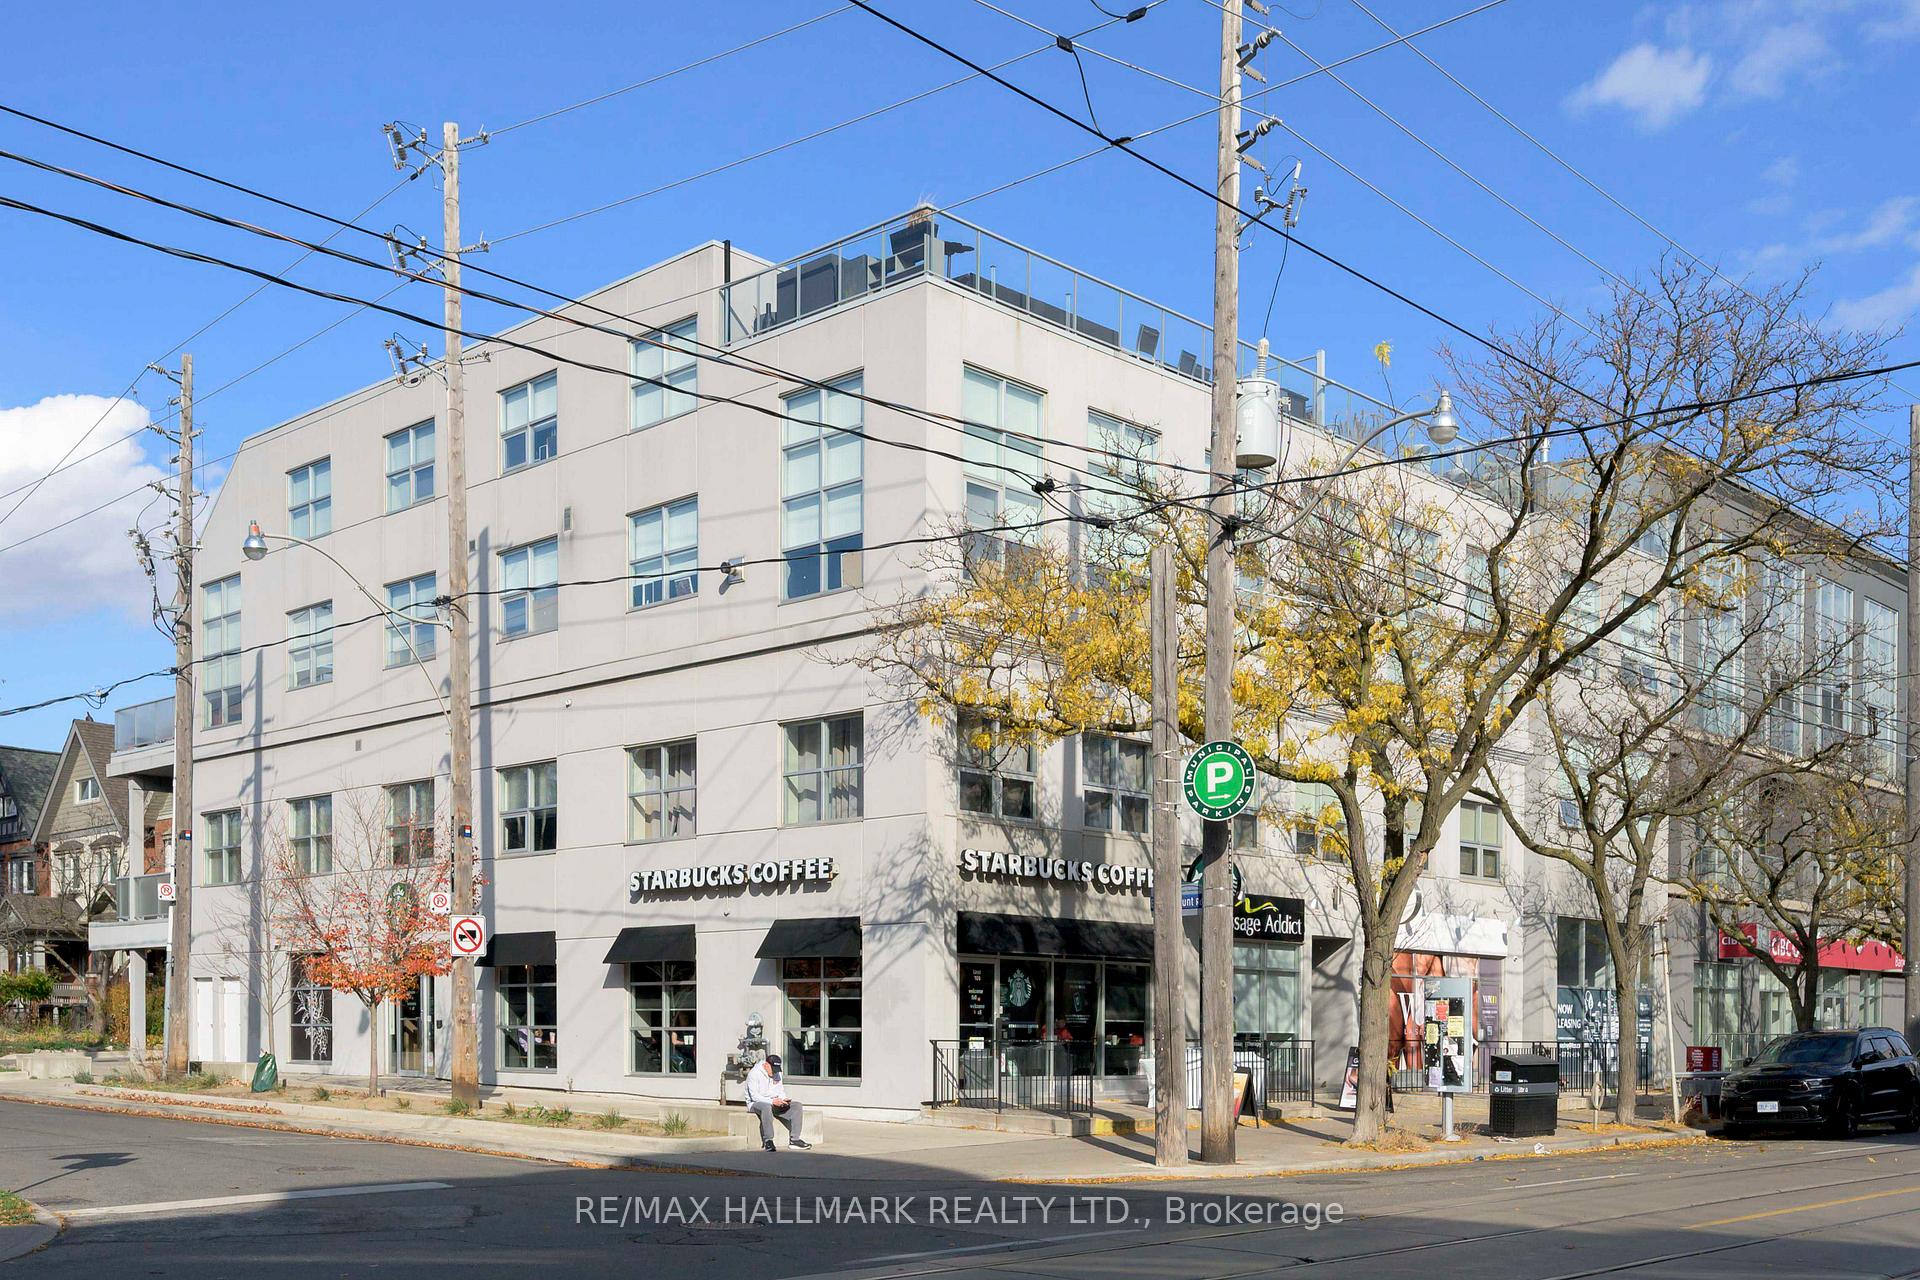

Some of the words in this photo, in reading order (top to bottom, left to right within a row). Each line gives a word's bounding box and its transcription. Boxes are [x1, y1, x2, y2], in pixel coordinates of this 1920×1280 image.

[1186, 744, 1252, 780] MUNICIPAL
[1206, 761, 1234, 793] P
[1186, 785, 1251, 817] PARKING
[630, 863, 745, 892] STARBUCKS
[750, 857, 831, 884] COFFEE
[963, 848, 1092, 882] STARBUCKS
[1233, 916, 1261, 937] sage
[1265, 913, 1302, 935] Addict
[1557, 1004, 1574, 1014] NOW
[1557, 1019, 1582, 1029] LEASING
[1500, 1085, 1514, 1093] Litter
